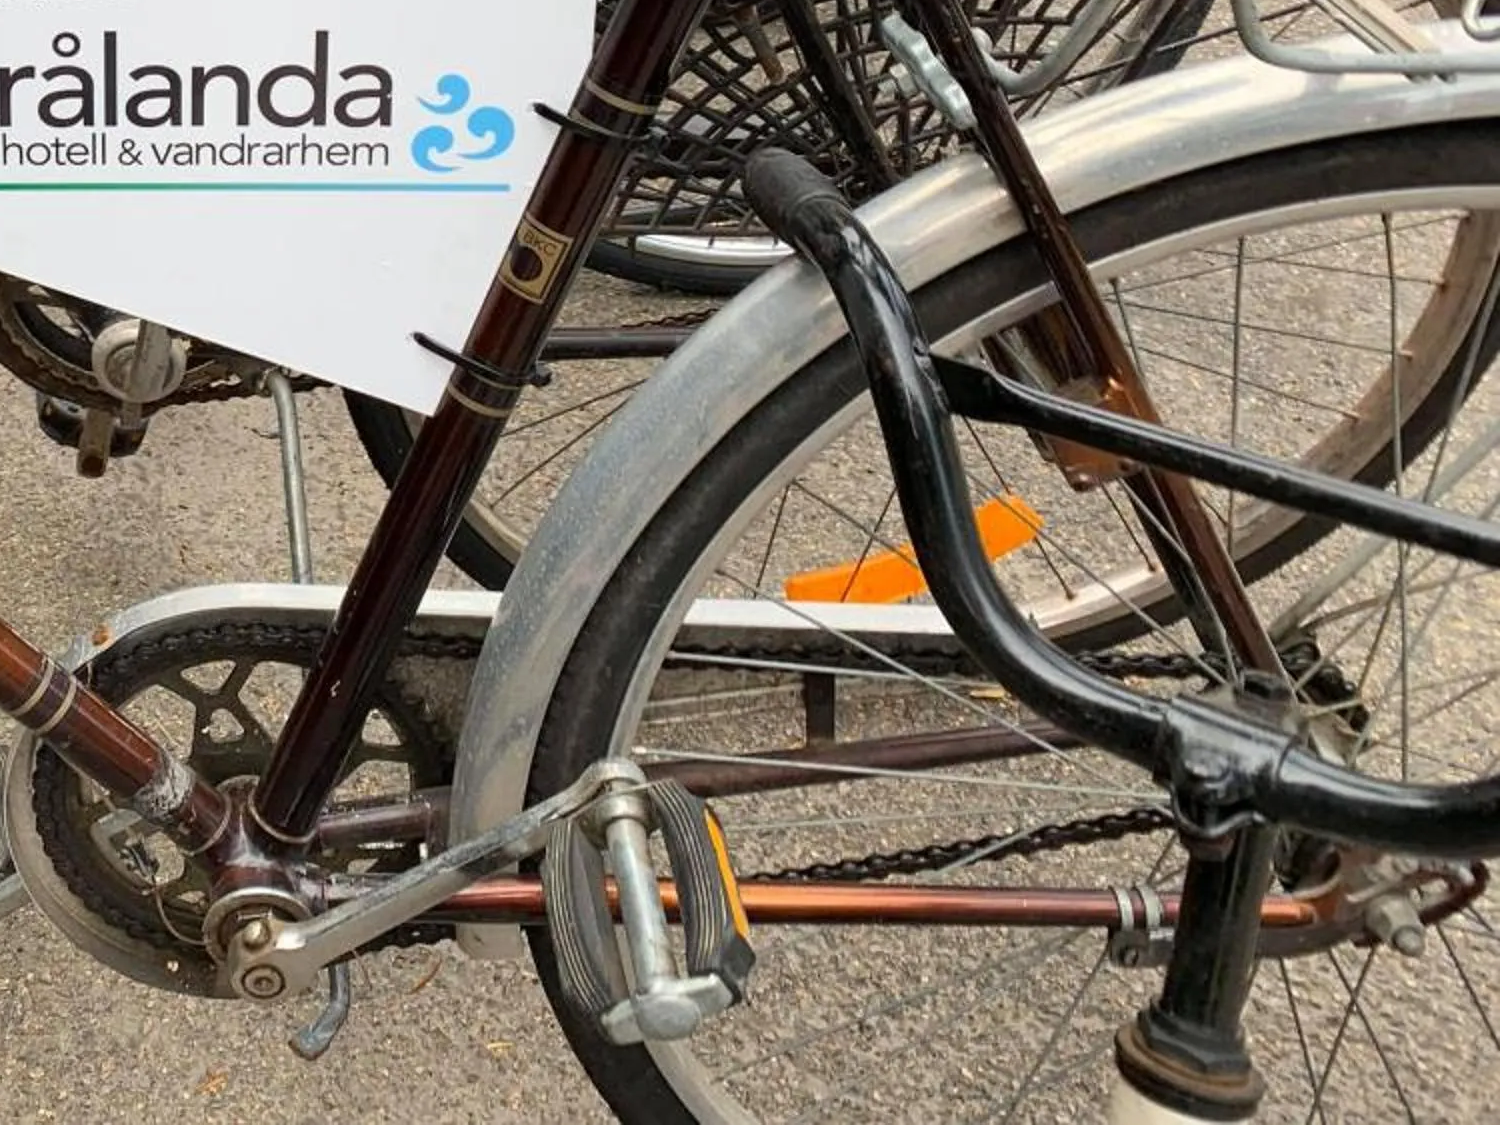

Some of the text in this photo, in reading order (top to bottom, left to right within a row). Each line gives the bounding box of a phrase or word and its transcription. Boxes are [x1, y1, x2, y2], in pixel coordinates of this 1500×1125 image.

[2, 132, 389, 167] hotell & vandrarhem
